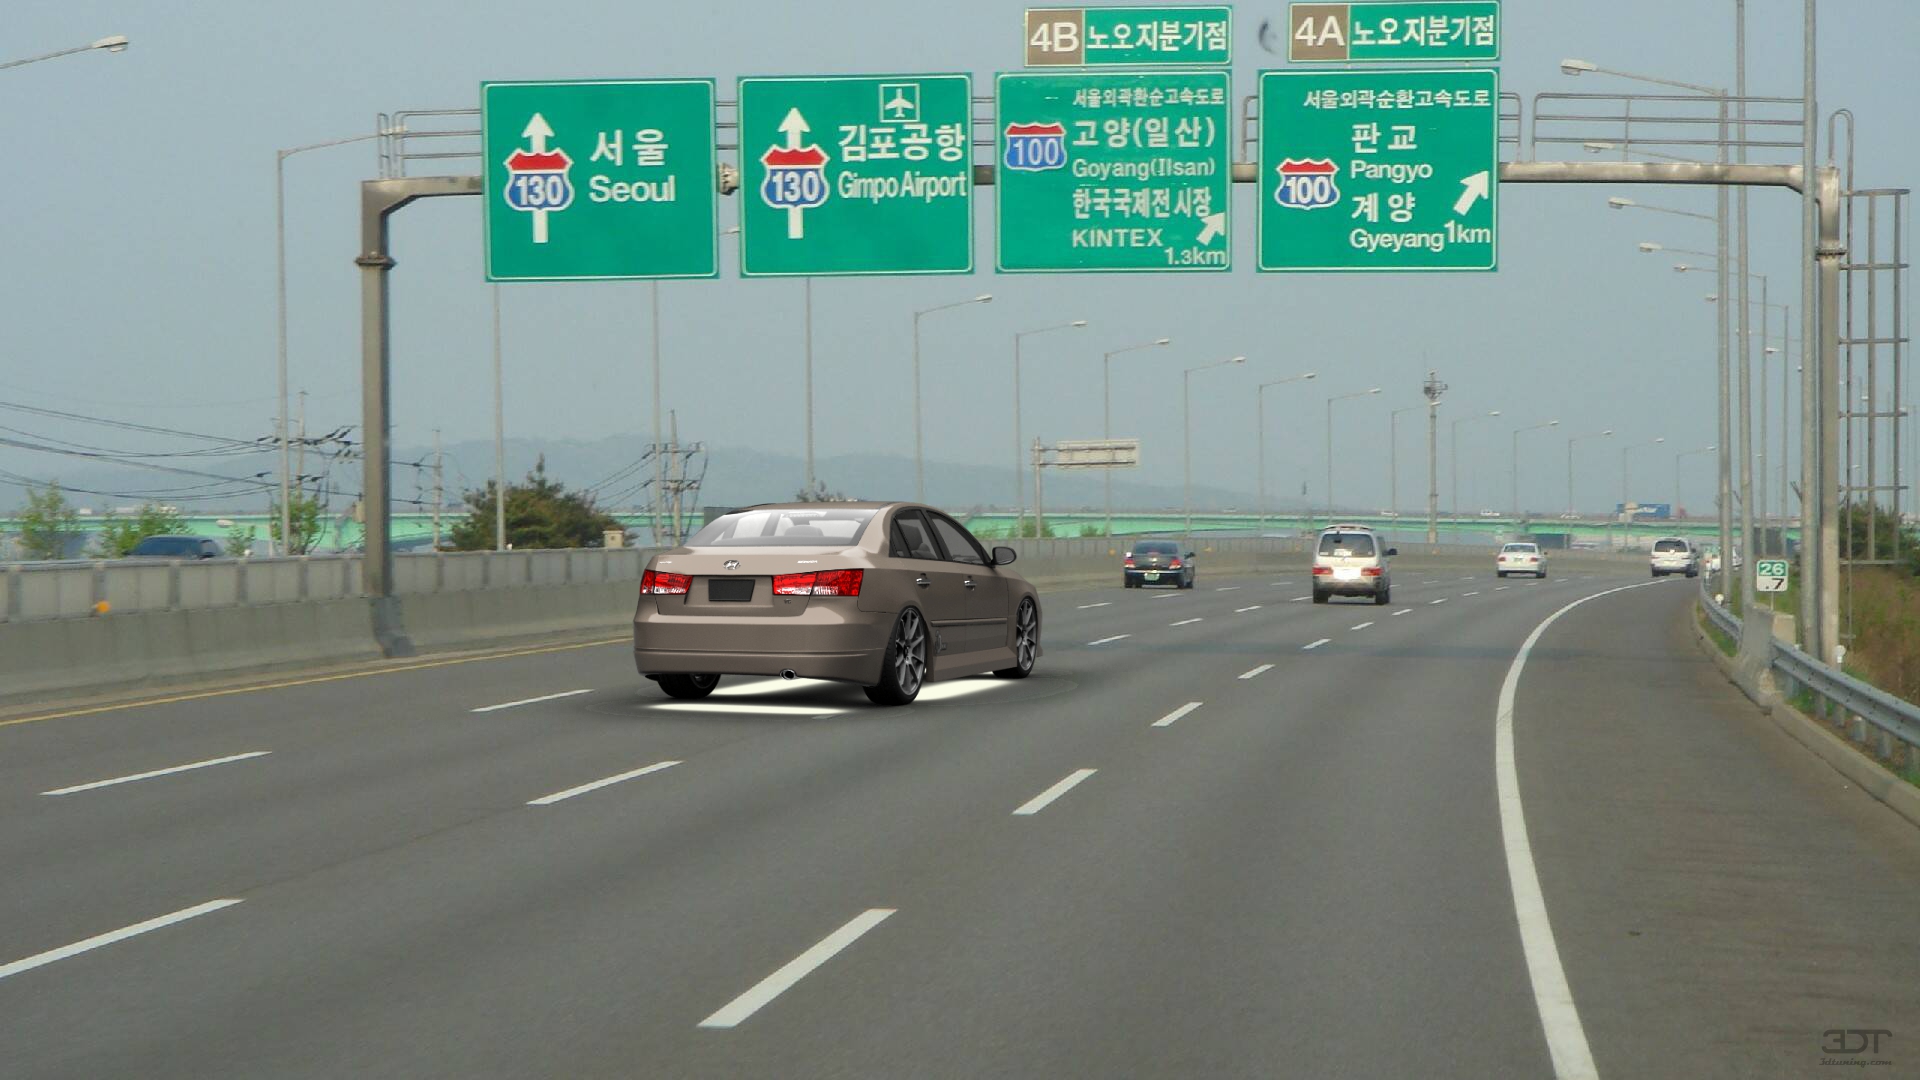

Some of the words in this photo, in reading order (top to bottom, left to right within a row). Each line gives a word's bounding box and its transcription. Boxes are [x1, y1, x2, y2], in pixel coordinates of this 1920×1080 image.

[1030, 21, 1080, 52] 4B
[1294, 15, 1346, 47] 4A
[1303, 89, 1492, 109] 서울외곽순환고속도로
[838, 122, 966, 162] 김포공항
[1013, 138, 1059, 166] 100
[772, 170, 820, 202] 130
[1351, 160, 1433, 184] Pangyo
[514, 175, 564, 206] 130
[588, 174, 676, 203] Seoul
[838, 170, 899, 204] Gimpo
[899, 170, 967, 203] Airport
[1286, 175, 1331, 204] 100
[1072, 229, 1163, 248] KINTEX
[1350, 228, 1445, 253] Gyeyang
[1444, 220, 1491, 244] 1km
[1164, 246, 1226, 266] 1.3km
[1760, 563, 1785, 576] 26
